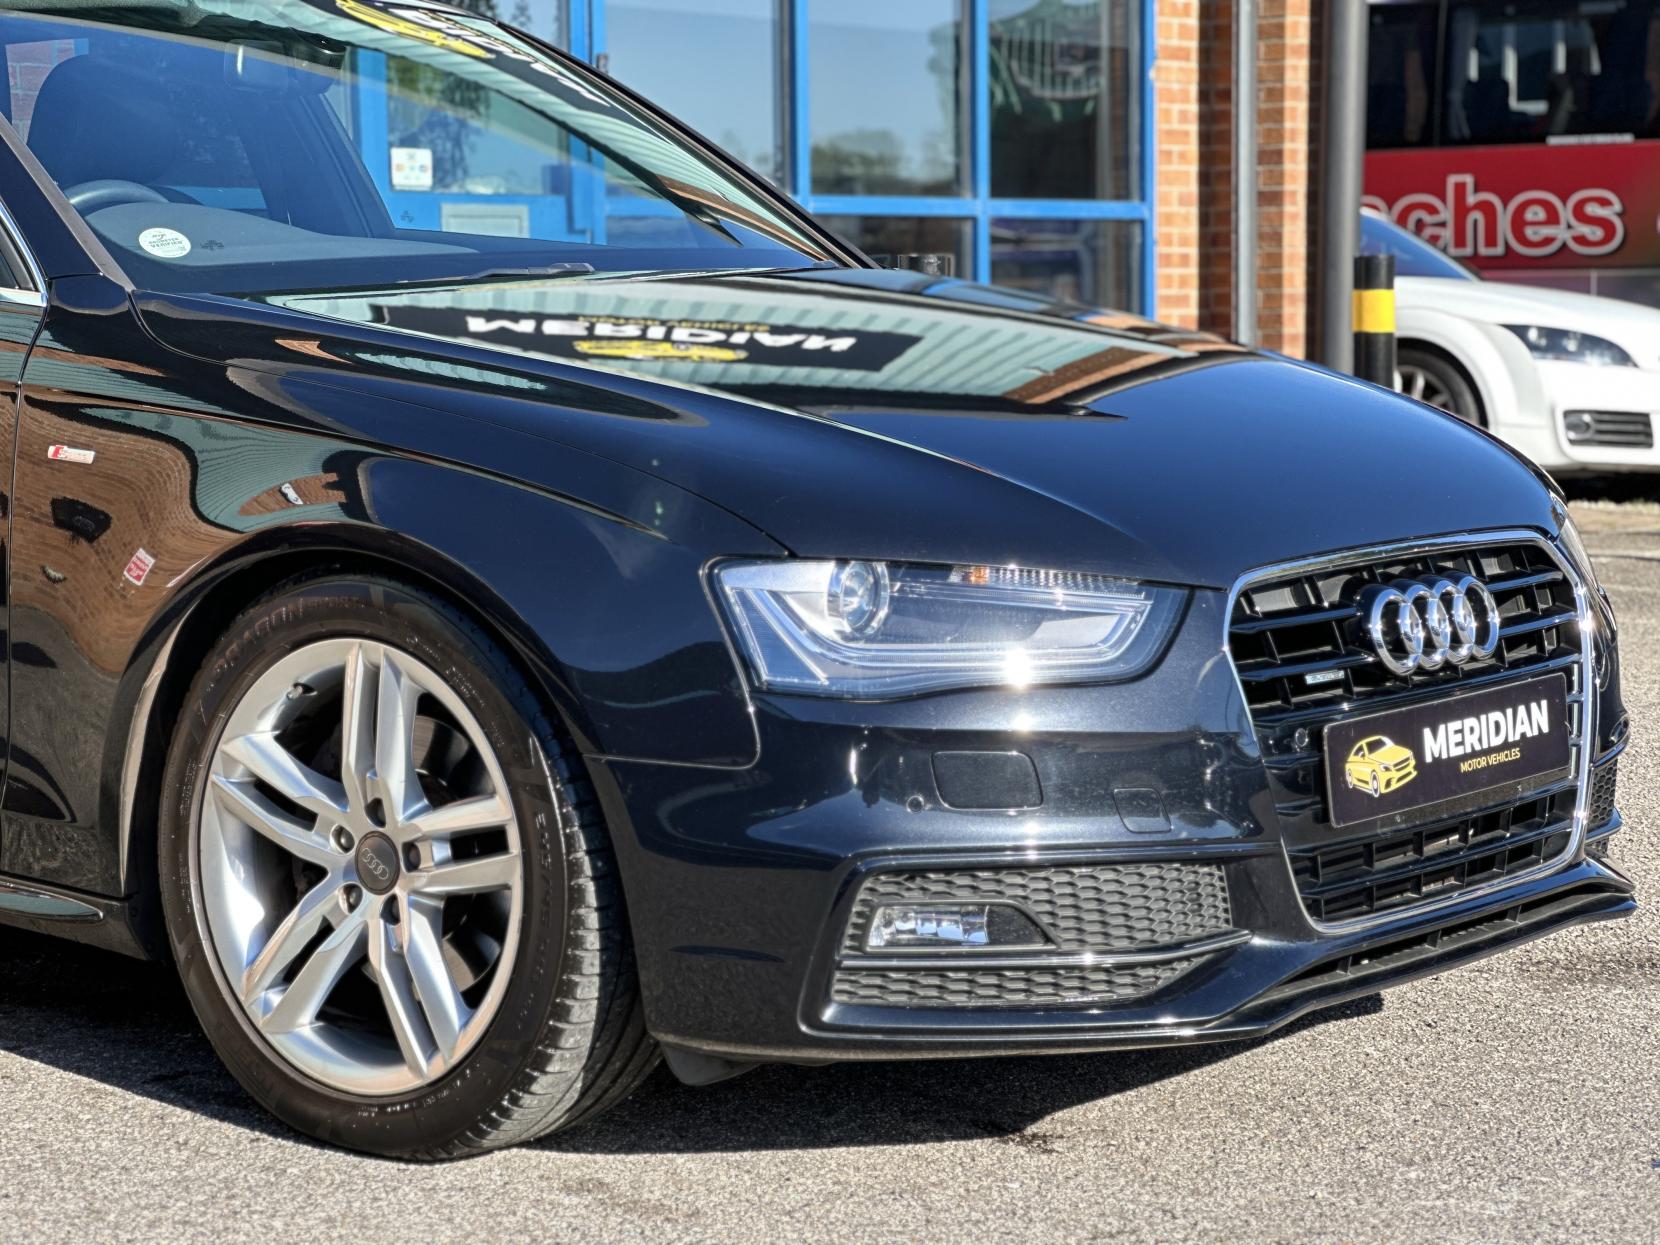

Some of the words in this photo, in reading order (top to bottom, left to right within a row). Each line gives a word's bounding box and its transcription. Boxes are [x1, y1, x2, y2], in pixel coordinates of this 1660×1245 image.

[1361, 173, 1625, 256] ches
[1423, 699, 1549, 763] MERIDIAN
[1460, 756, 1488, 773] MOTOR
[1488, 747, 1521, 766] VEHICLES
